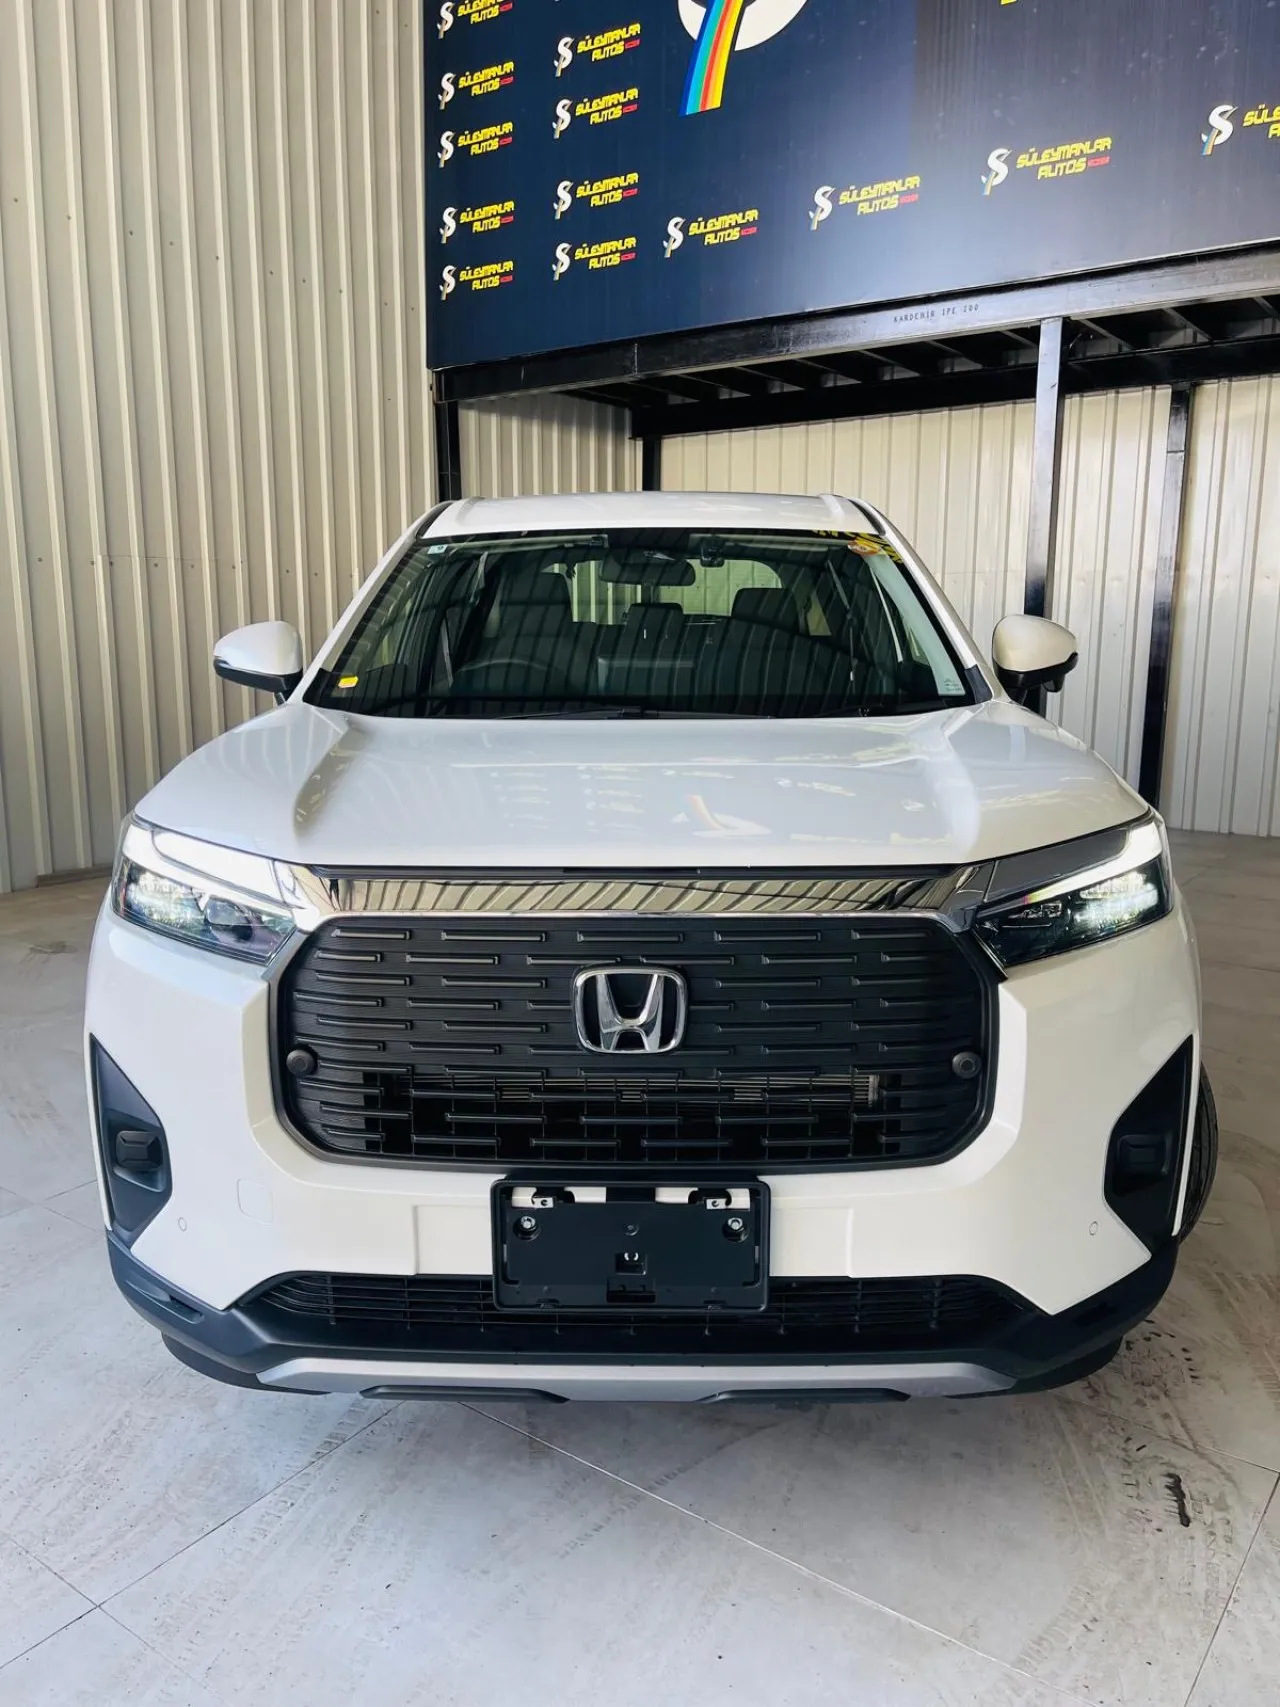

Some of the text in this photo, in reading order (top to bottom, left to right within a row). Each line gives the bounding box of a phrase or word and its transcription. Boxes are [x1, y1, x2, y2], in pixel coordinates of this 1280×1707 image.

[470, 5, 500, 24] AUTOS
[592, 40, 625, 62] AUTOS
[471, 78, 500, 96] AUTOS
[590, 105, 623, 125] AUTOS
[470, 138, 500, 156] AUTOS
[1037, 157, 1088, 180] AUTOS
[590, 188, 623, 207] AUTOS
[857, 194, 901, 216] AUTOS
[472, 216, 501, 233] AUTOS
[704, 227, 741, 246] AUTOS
[588, 252, 622, 270] AUTOS
[471, 274, 500, 291] AUTOS
